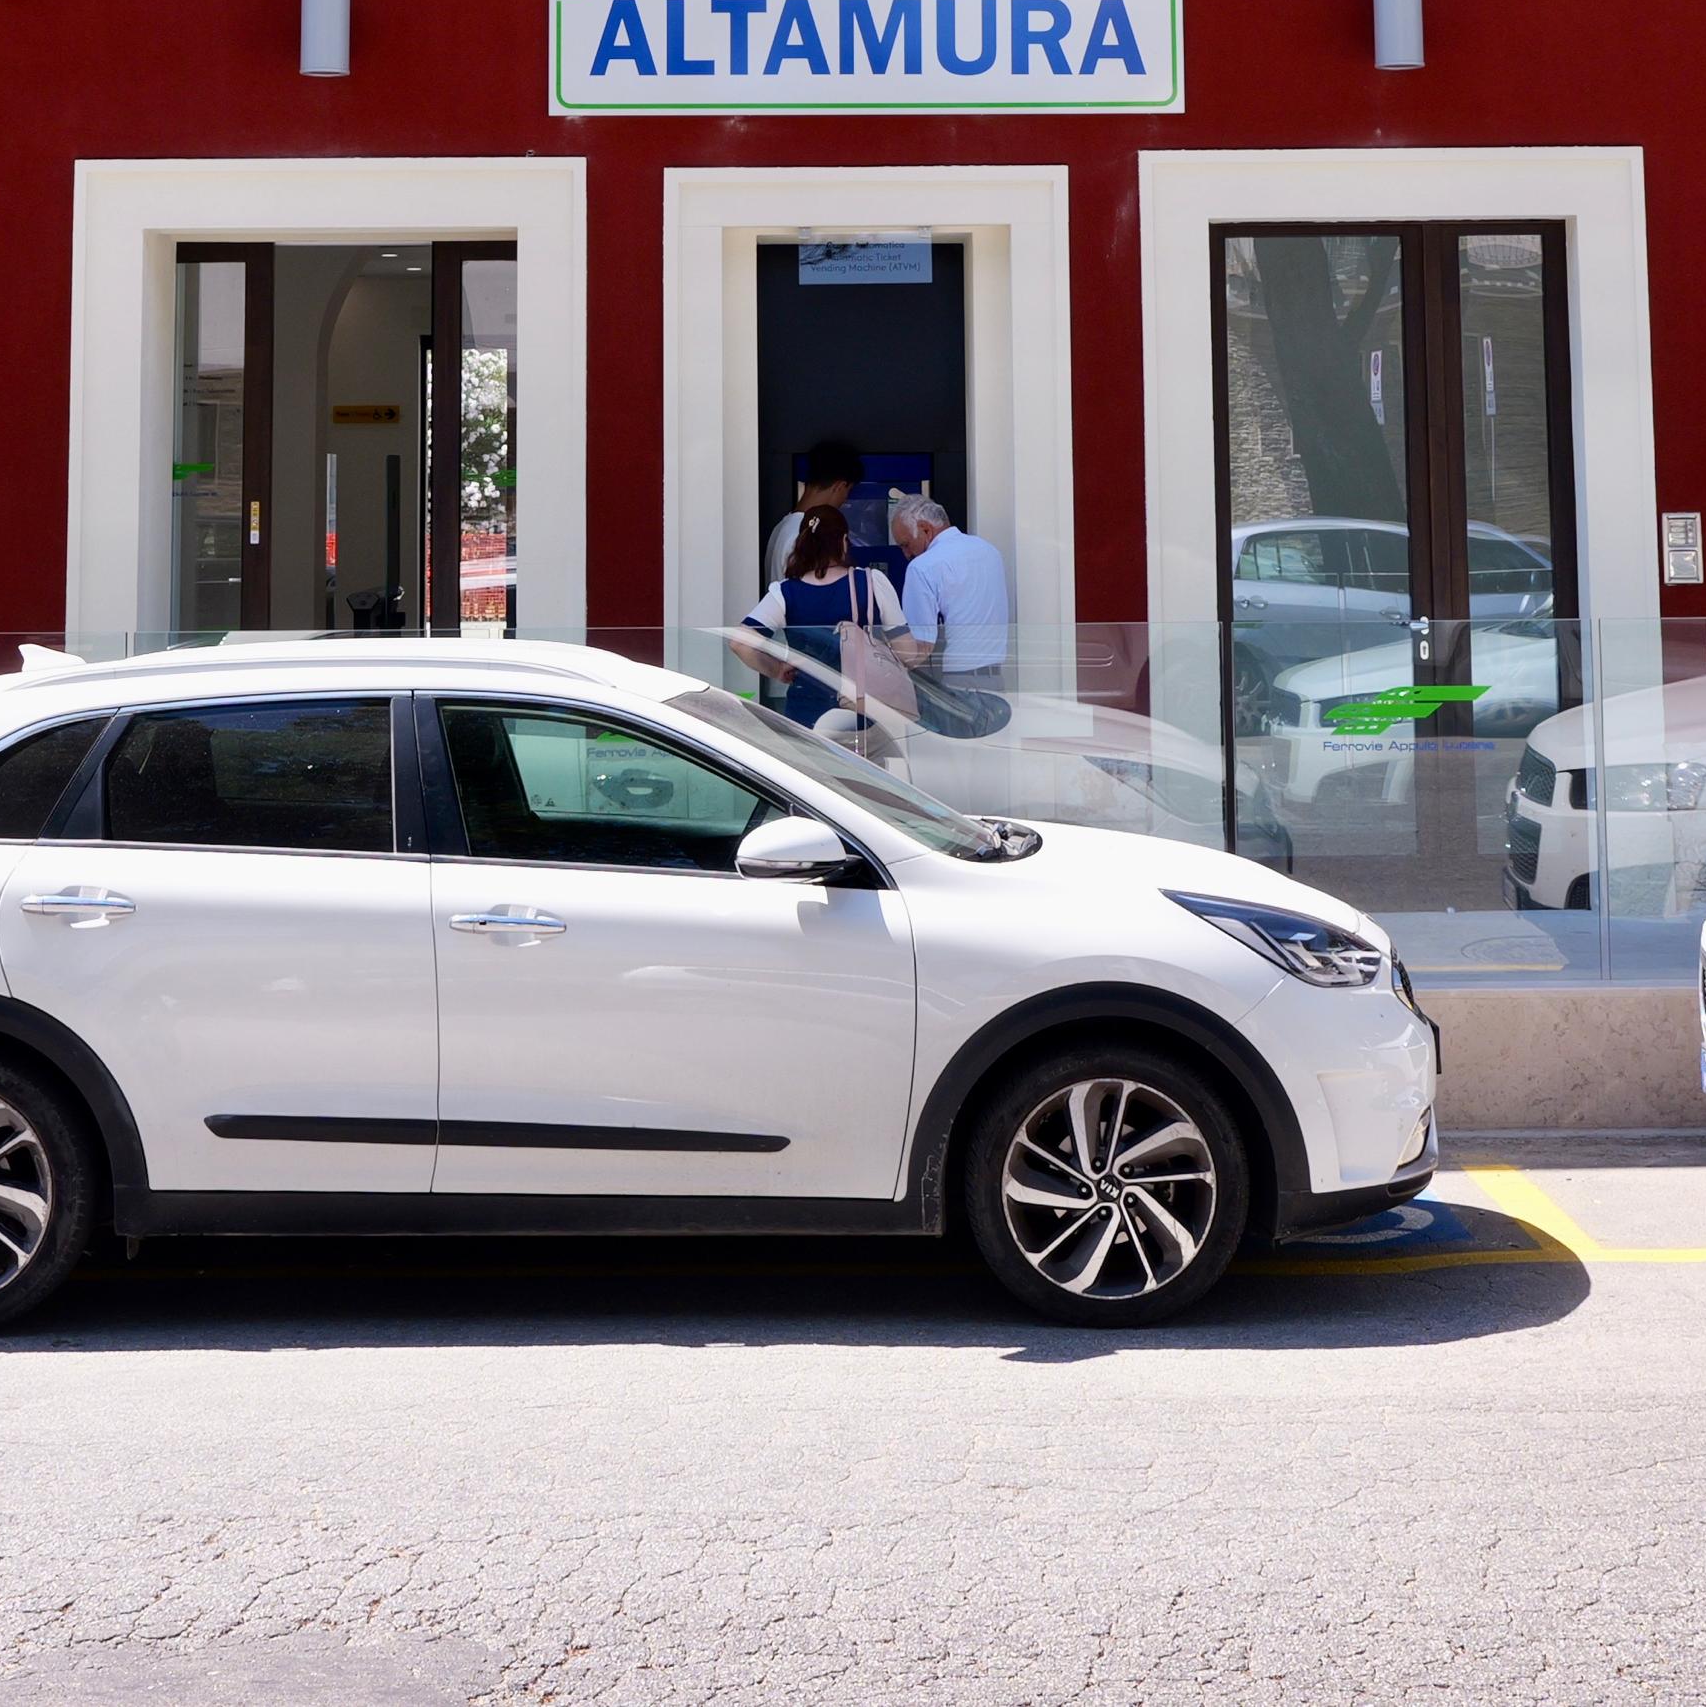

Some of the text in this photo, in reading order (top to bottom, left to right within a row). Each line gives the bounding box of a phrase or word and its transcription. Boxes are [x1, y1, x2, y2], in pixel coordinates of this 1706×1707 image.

[876, 253, 901, 261] Ticket
[811, 263, 921, 273] Vending Machine (ATVM)
[1323, 741, 1383, 751] Ferrovie
[1389, 740, 1438, 752] Appulo
[586, 747, 647, 759] Ferrovie
[1100, 1179, 1120, 1199] KIA
